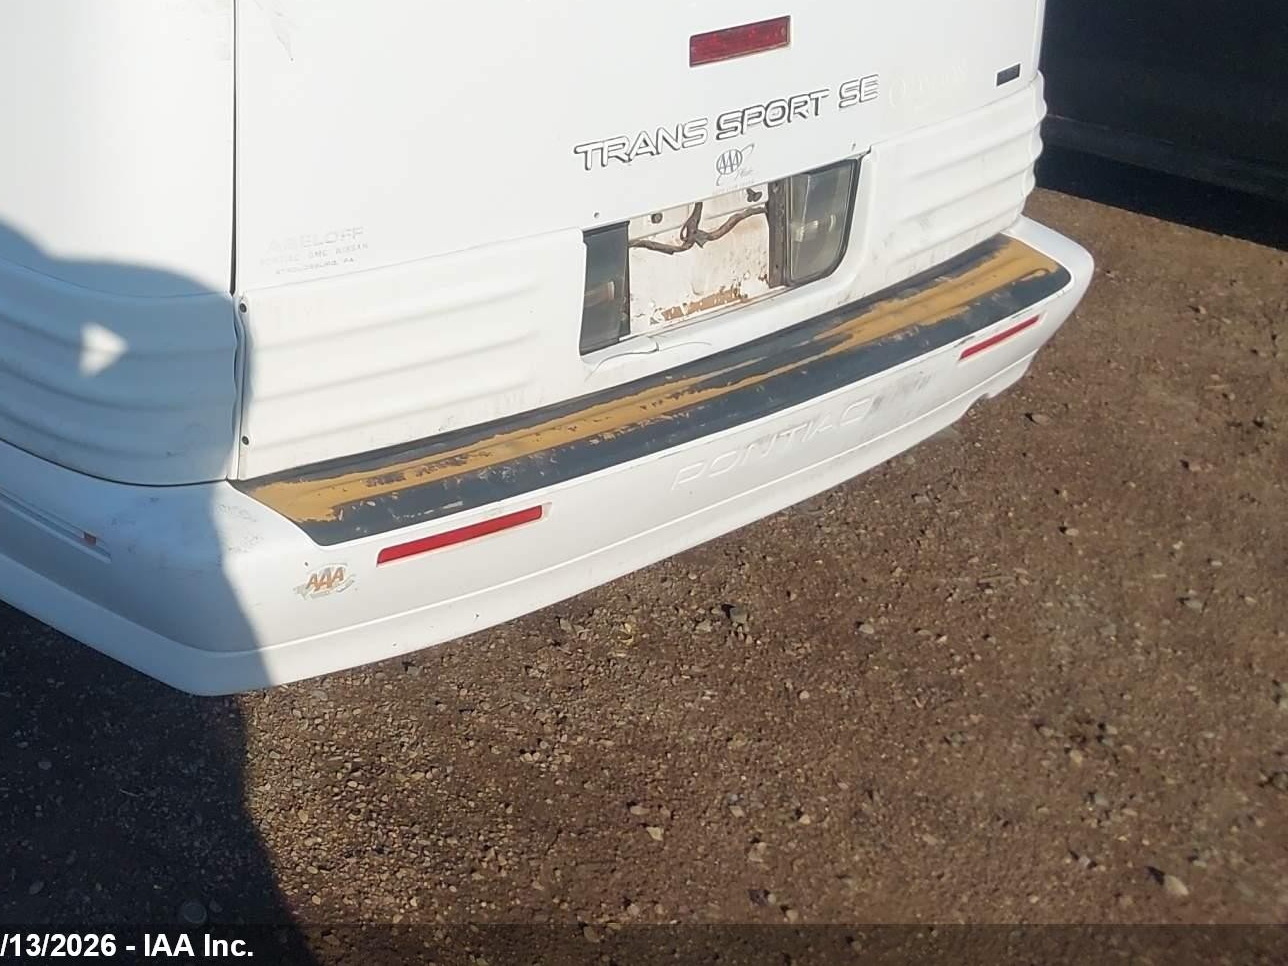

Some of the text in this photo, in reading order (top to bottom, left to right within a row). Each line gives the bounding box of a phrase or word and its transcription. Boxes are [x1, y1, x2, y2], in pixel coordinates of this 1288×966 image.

[574, 118, 708, 171] TRANS
[716, 89, 830, 140] SPORT
[838, 74, 880, 109] SE
[716, 149, 743, 175] AAA
[305, 565, 345, 592] AAA
